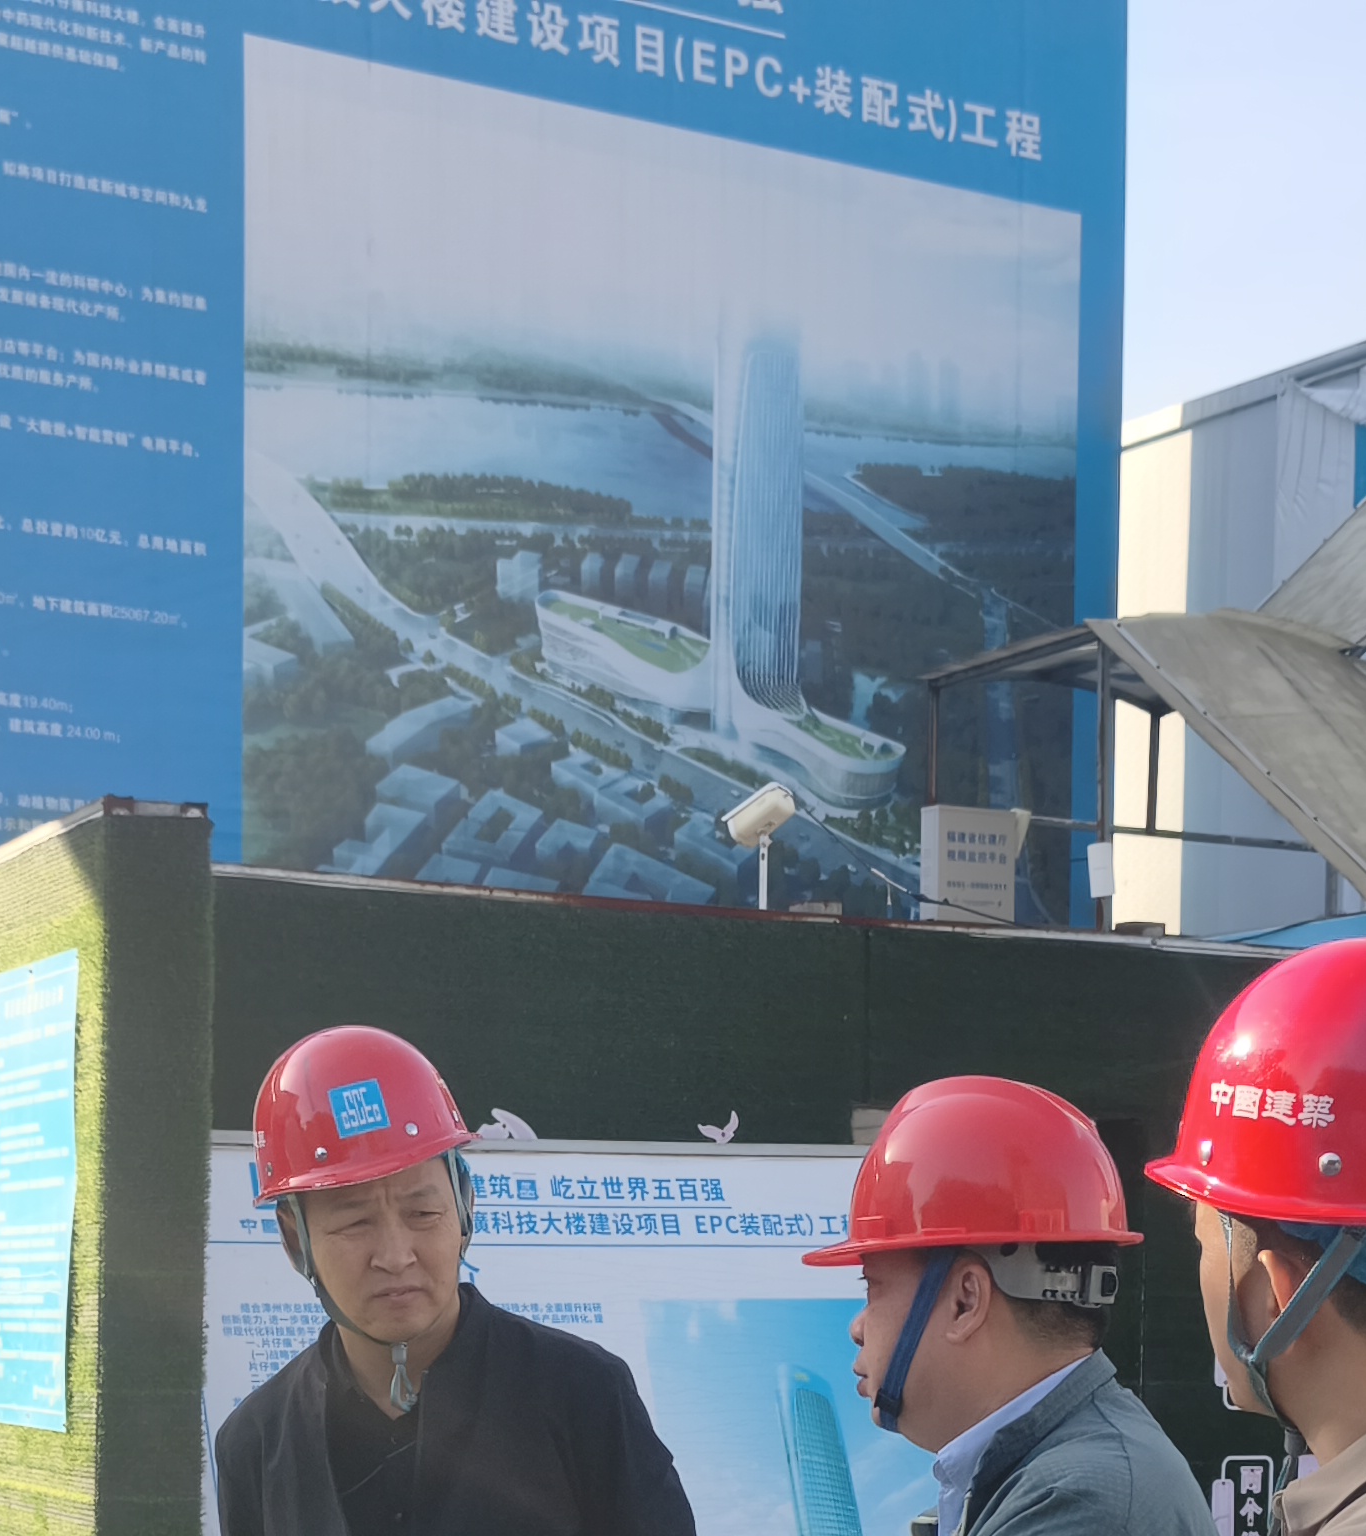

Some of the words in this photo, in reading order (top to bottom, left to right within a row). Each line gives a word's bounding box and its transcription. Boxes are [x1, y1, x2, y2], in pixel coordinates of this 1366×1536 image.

[319, 0, 1044, 162] 楼建设项目(EPC+装配式)工程
[1210, 1078, 1336, 1129] 中國建築
[549, 1174, 726, 1203] 屹立世界五百强
